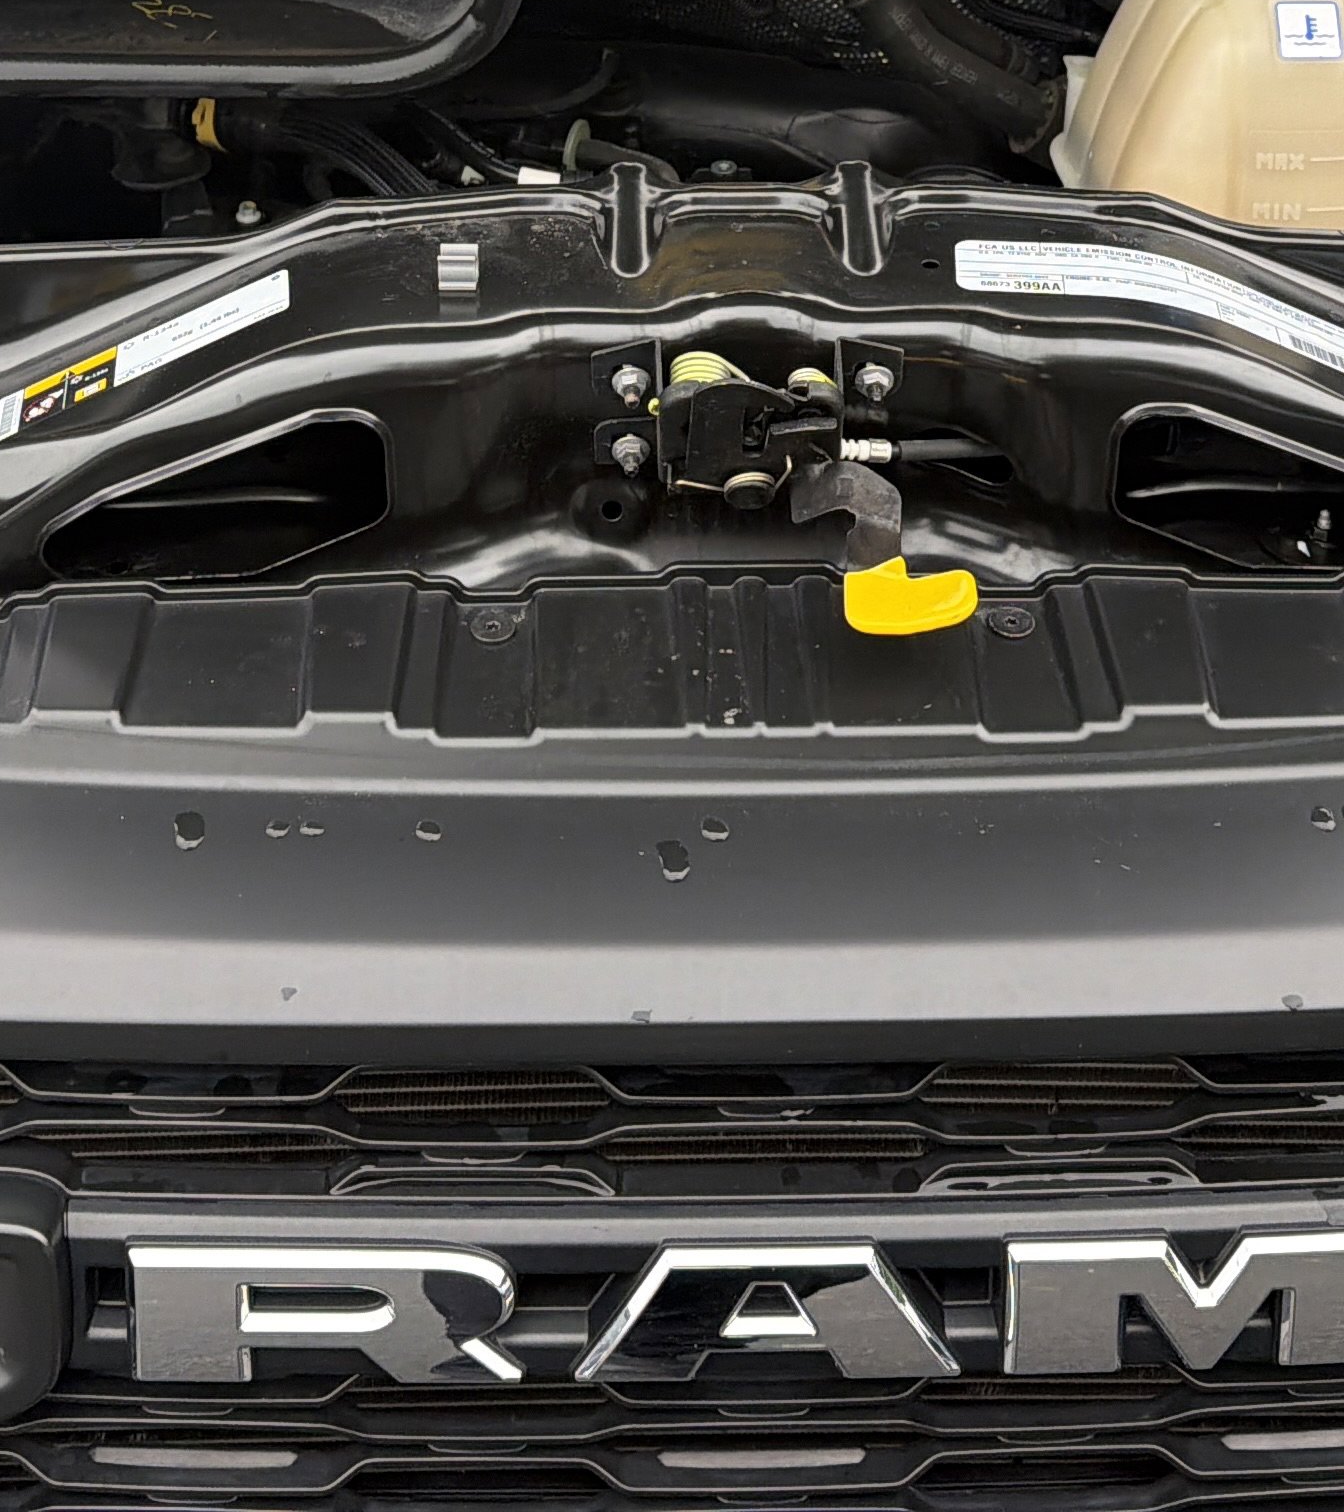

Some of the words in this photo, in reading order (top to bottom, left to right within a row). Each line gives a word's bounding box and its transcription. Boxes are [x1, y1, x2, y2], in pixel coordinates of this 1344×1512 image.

[1256, 152, 1305, 170] MAX
[1252, 202, 1302, 220] MIN
[1085, 247, 1132, 258] EMISSION
[1013, 280, 1062, 291] 399AA
